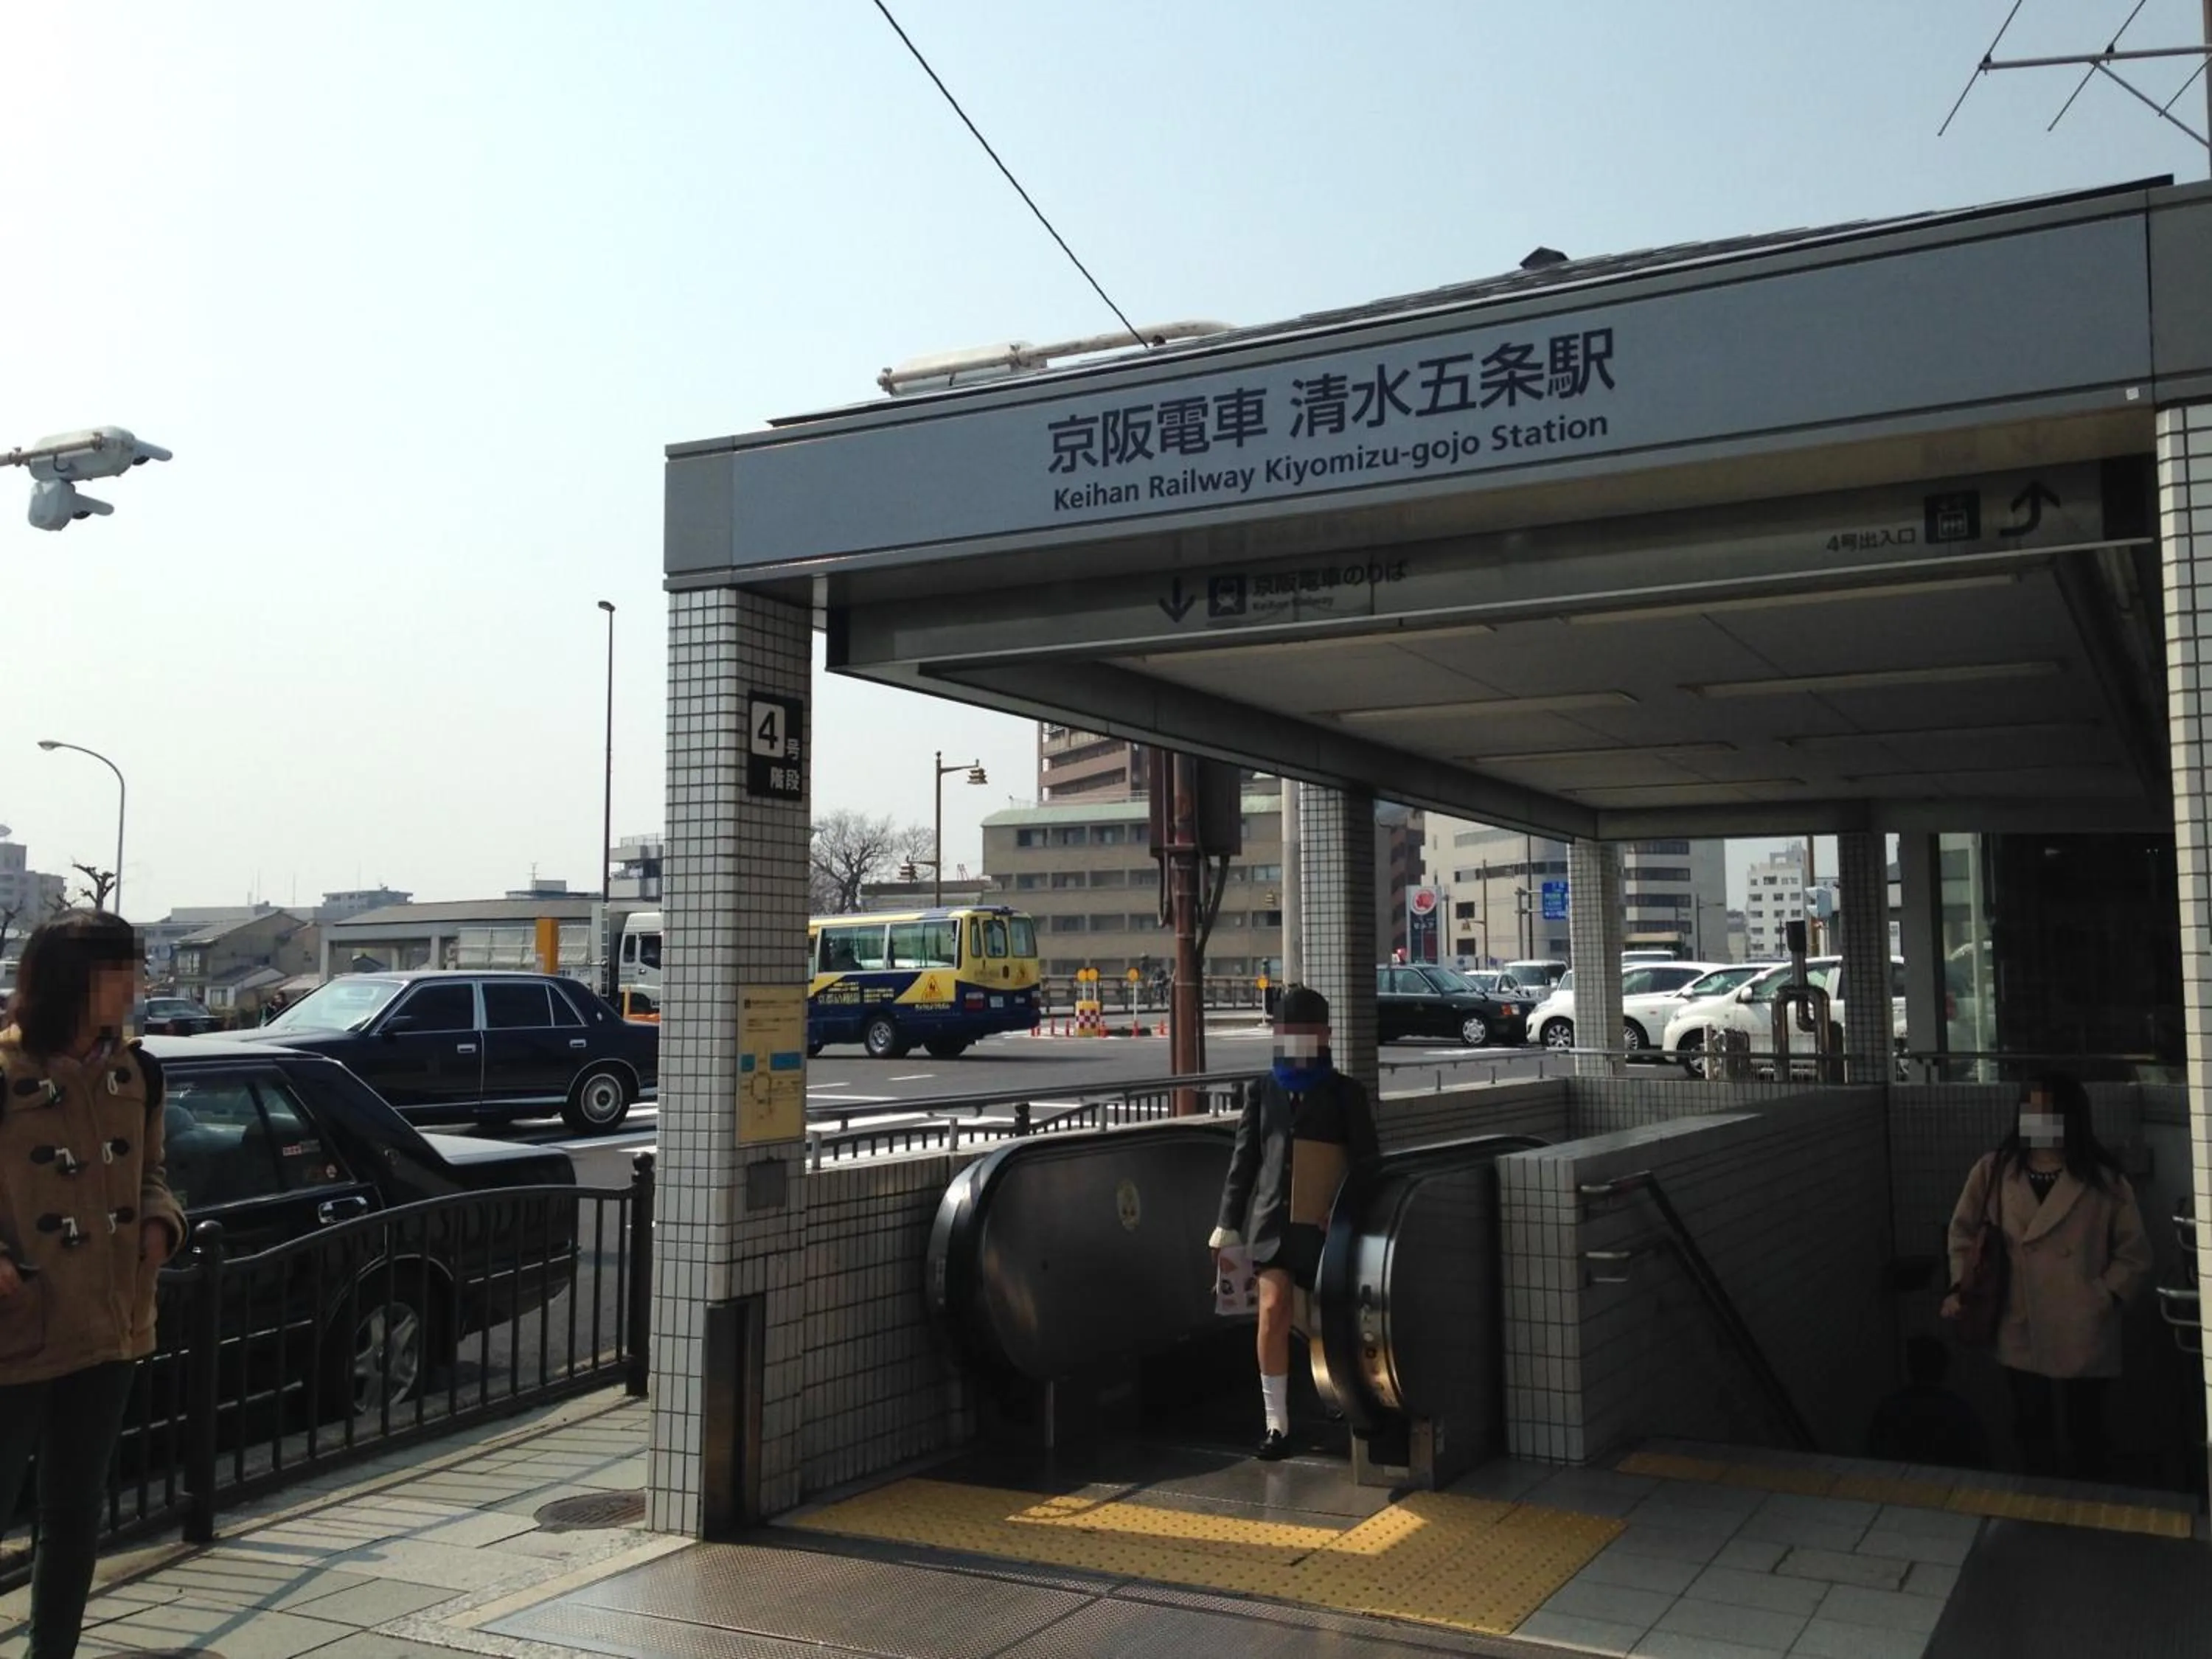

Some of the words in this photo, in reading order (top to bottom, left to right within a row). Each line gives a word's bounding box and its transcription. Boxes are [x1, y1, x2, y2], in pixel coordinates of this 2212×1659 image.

[1048, 388, 1268, 474] 京阪電車
[1289, 327, 1615, 439] 清水五条駅
[1054, 481, 1140, 512] Keihan
[1149, 467, 1256, 499] Railway
[1265, 434, 1481, 487] Kiyomizu-gojo
[1492, 414, 1609, 452] Station
[1826, 526, 1916, 552] 4号出入口
[770, 766, 800, 791] 階段
